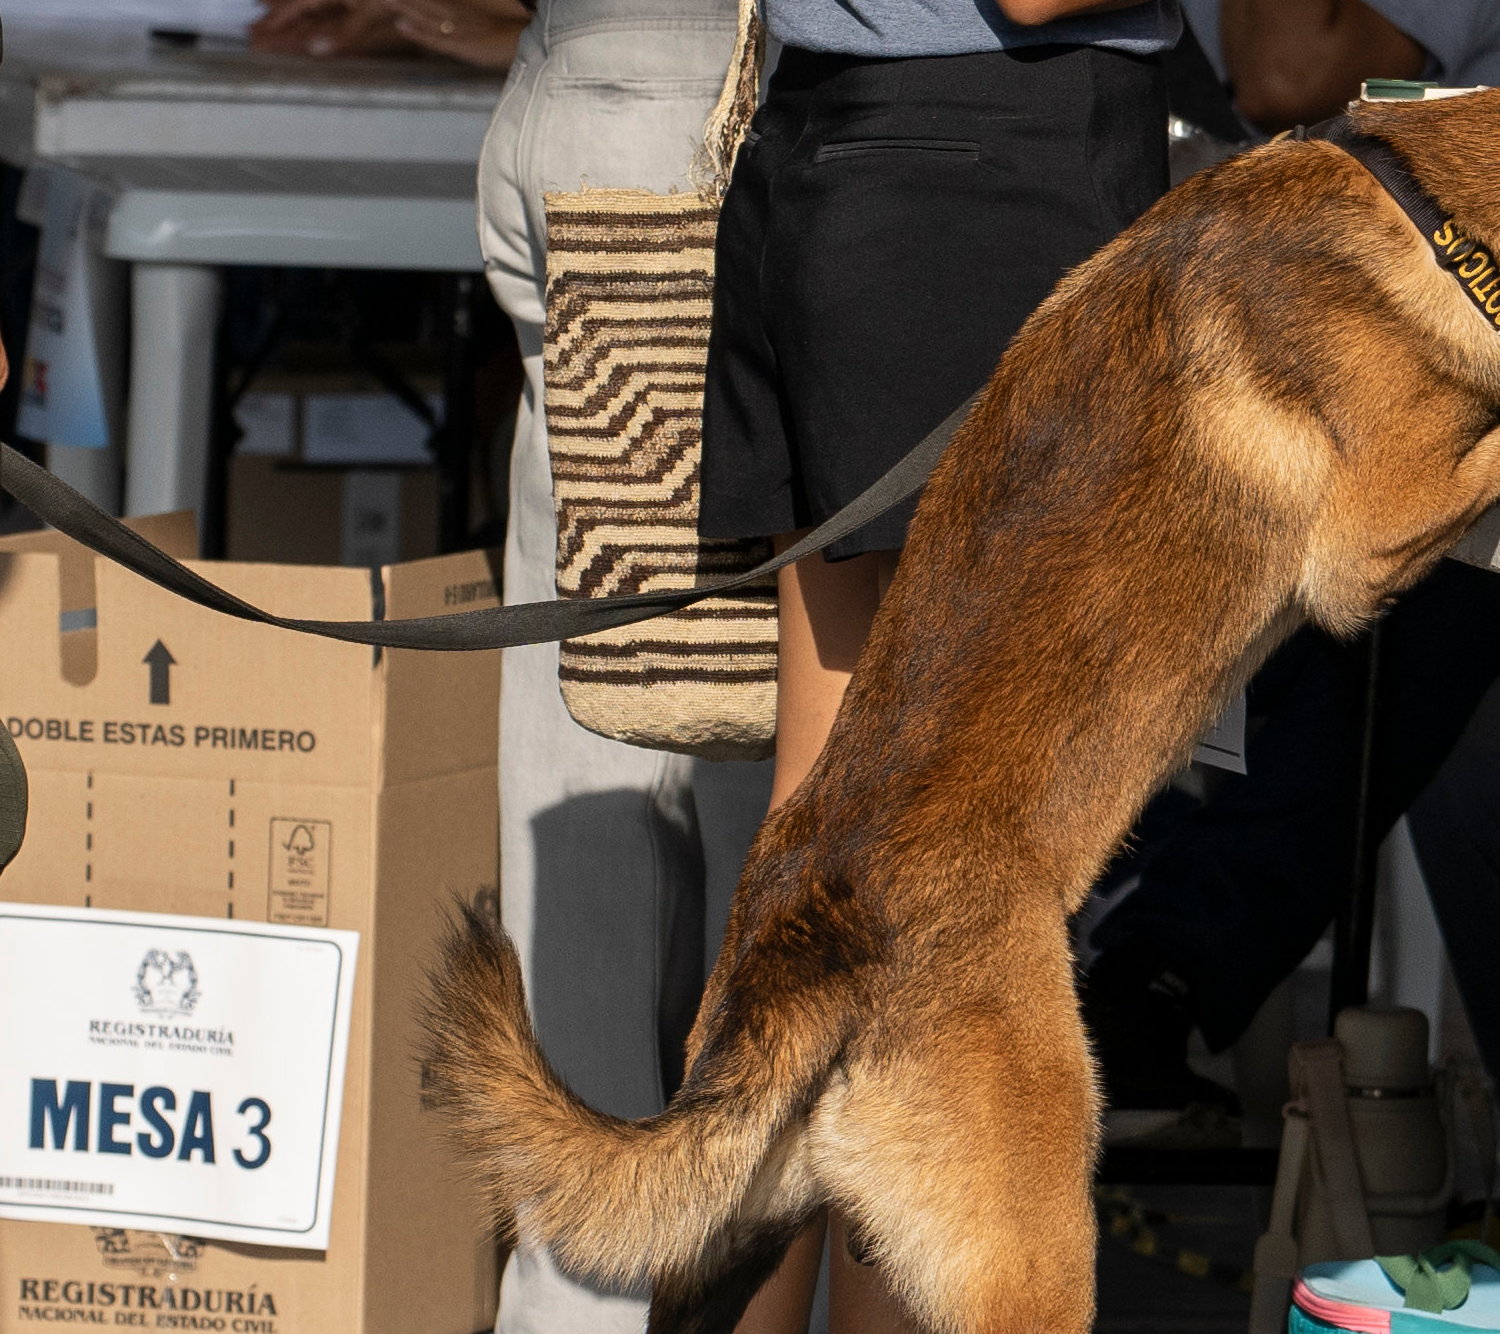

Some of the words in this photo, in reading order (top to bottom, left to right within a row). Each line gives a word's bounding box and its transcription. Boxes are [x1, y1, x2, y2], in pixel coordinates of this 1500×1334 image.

[5, 716, 95, 743] DOBLE
[102, 721, 186, 748] ESTAS
[194, 725, 317, 754] PRIMERO
[88, 1019, 236, 1047] REGISTRADURÍA
[28, 1077, 217, 1165] MESA
[231, 1096, 272, 1170] 3
[19, 1277, 279, 1317] REGISTRADURÍA
[18, 1305, 110, 1326] NACIONAL
[114, 1311, 150, 1328] DEL
[155, 1314, 226, 1332] ESTADO
